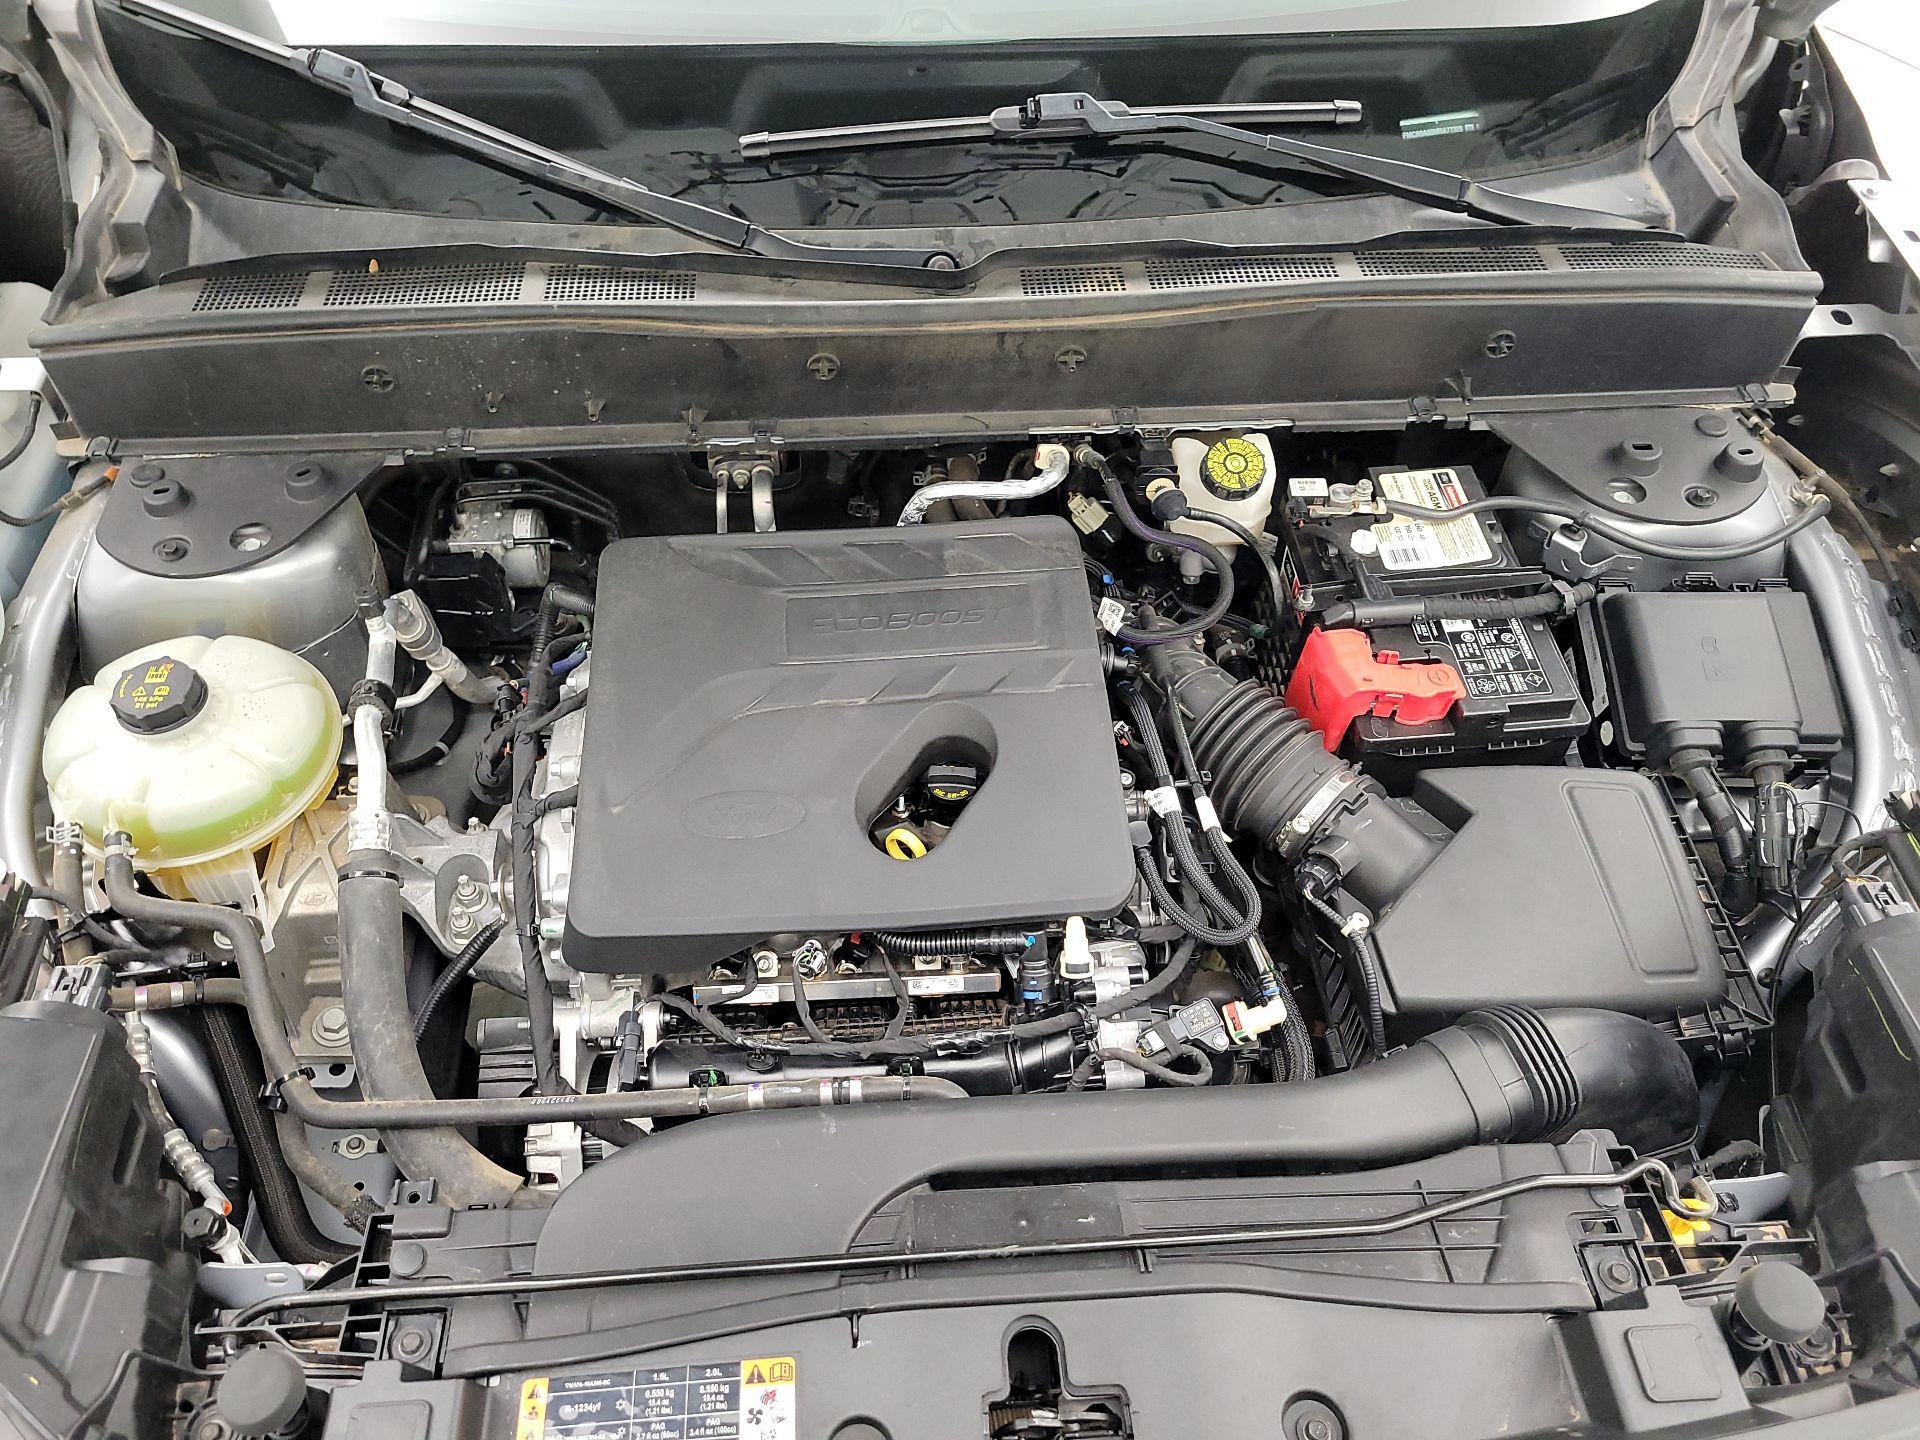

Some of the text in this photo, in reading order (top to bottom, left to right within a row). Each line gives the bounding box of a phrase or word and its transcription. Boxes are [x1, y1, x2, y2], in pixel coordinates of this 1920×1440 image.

[1428, 491, 1442, 509] AGM
[933, 788, 969, 798] SAE 5W-20
[653, 1372, 669, 1381] 1.5L
[705, 1367, 722, 1377] 2.0L
[665, 1388, 675, 1398] kg
[720, 1383, 730, 1394] kg
[564, 1401, 602, 1414] R-1234yf
[700, 1403, 715, 1412] (1.21
